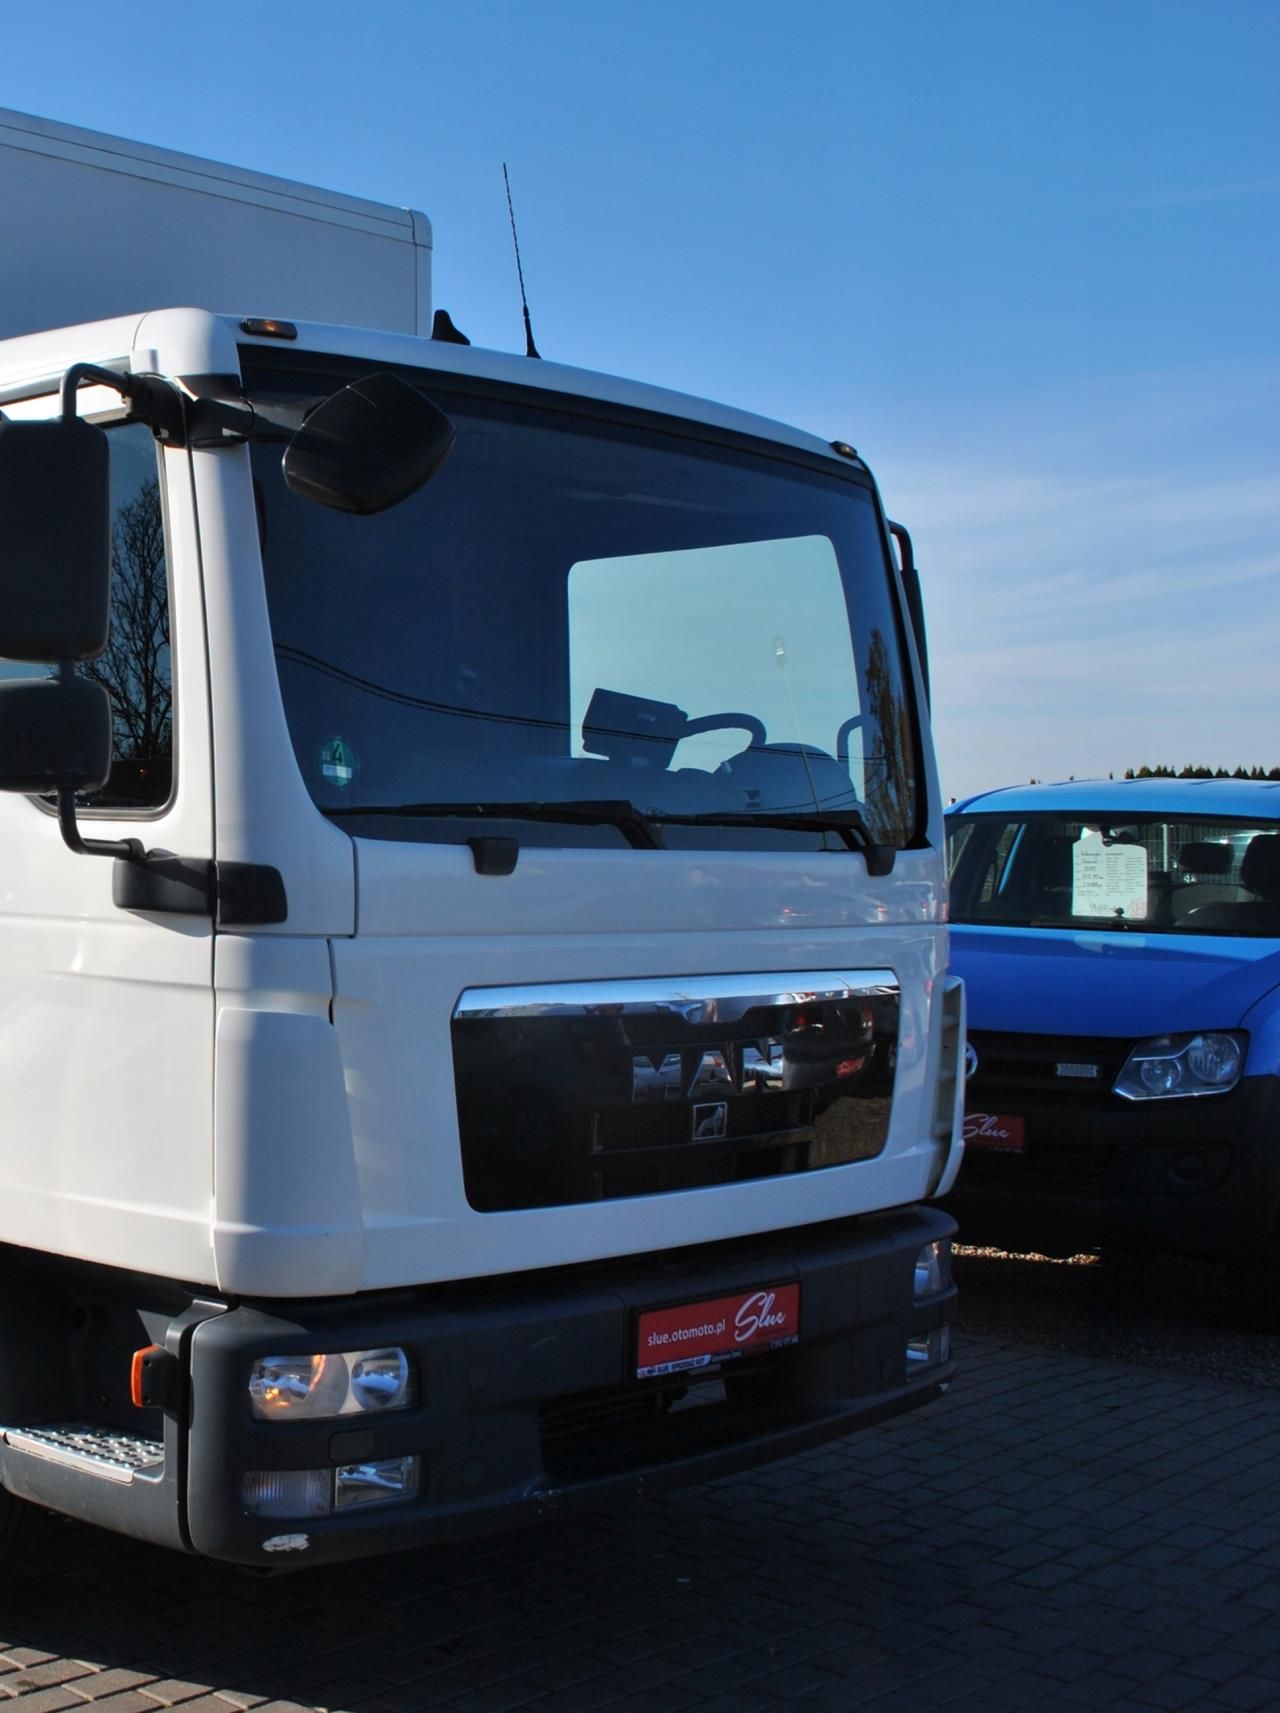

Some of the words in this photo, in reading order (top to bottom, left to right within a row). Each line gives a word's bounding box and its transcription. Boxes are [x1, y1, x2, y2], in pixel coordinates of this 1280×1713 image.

[332, 743, 344, 765] 4
[631, 1043, 785, 1103] MAN
[647, 1319, 726, 1346] slue.otomoto.pl
[734, 1291, 786, 1342] Slue
